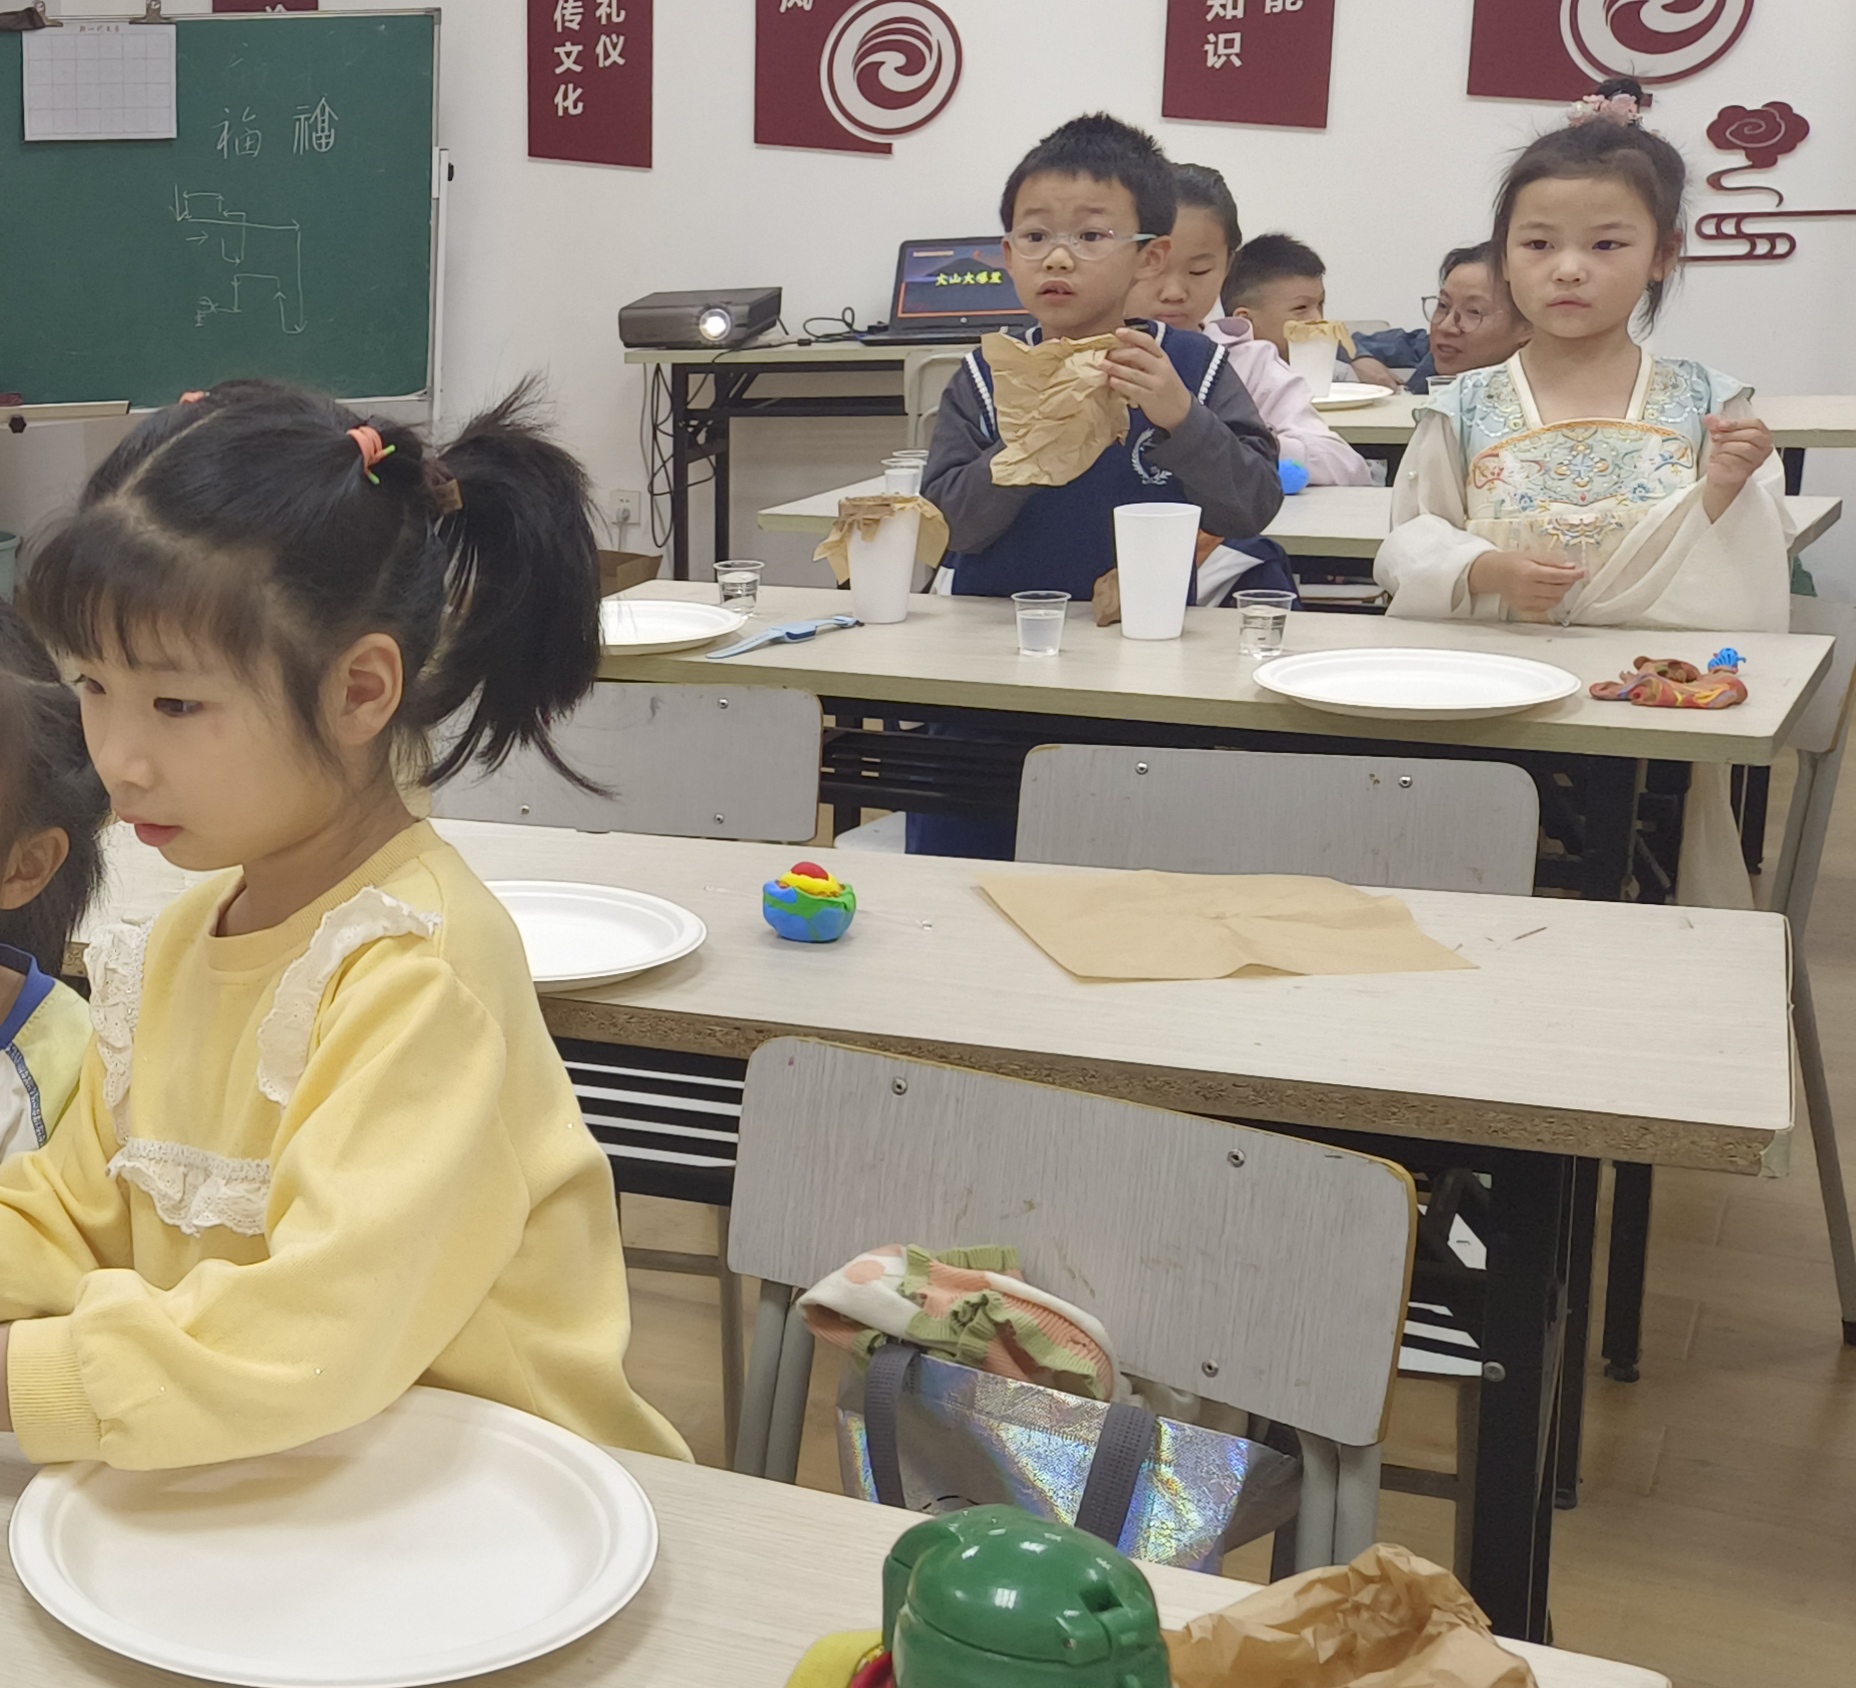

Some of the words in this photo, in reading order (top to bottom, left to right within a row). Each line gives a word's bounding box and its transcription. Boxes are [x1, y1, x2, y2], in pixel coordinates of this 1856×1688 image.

[553, 0, 584, 117] 传文化
[595, 0, 626, 68] 礼仪
[1203, 0, 1243, 69] 知识
